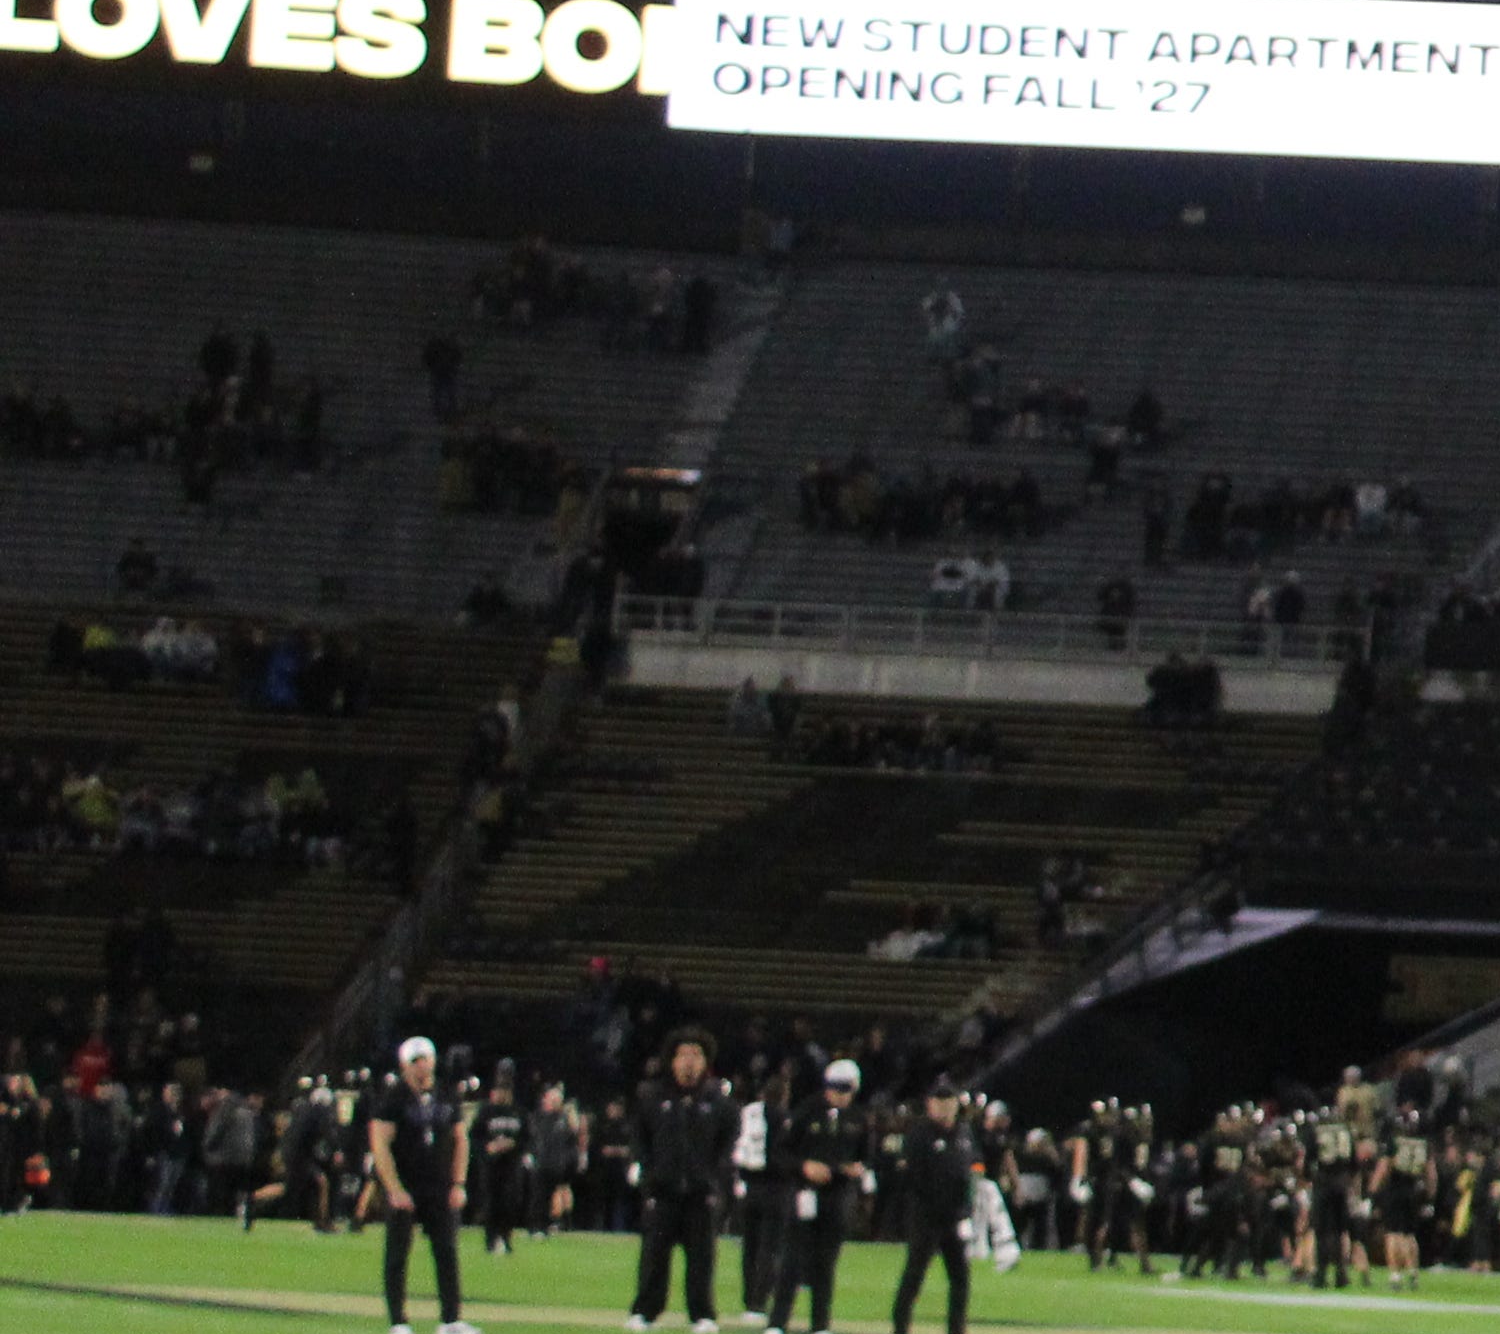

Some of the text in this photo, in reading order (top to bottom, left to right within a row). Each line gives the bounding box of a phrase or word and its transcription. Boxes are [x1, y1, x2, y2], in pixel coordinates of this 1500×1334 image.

[716, 13, 844, 49] NEW
[864, 18, 1128, 60] STUDENT
[713, 62, 963, 105] OPENING
[983, 74, 1117, 110] FALL
